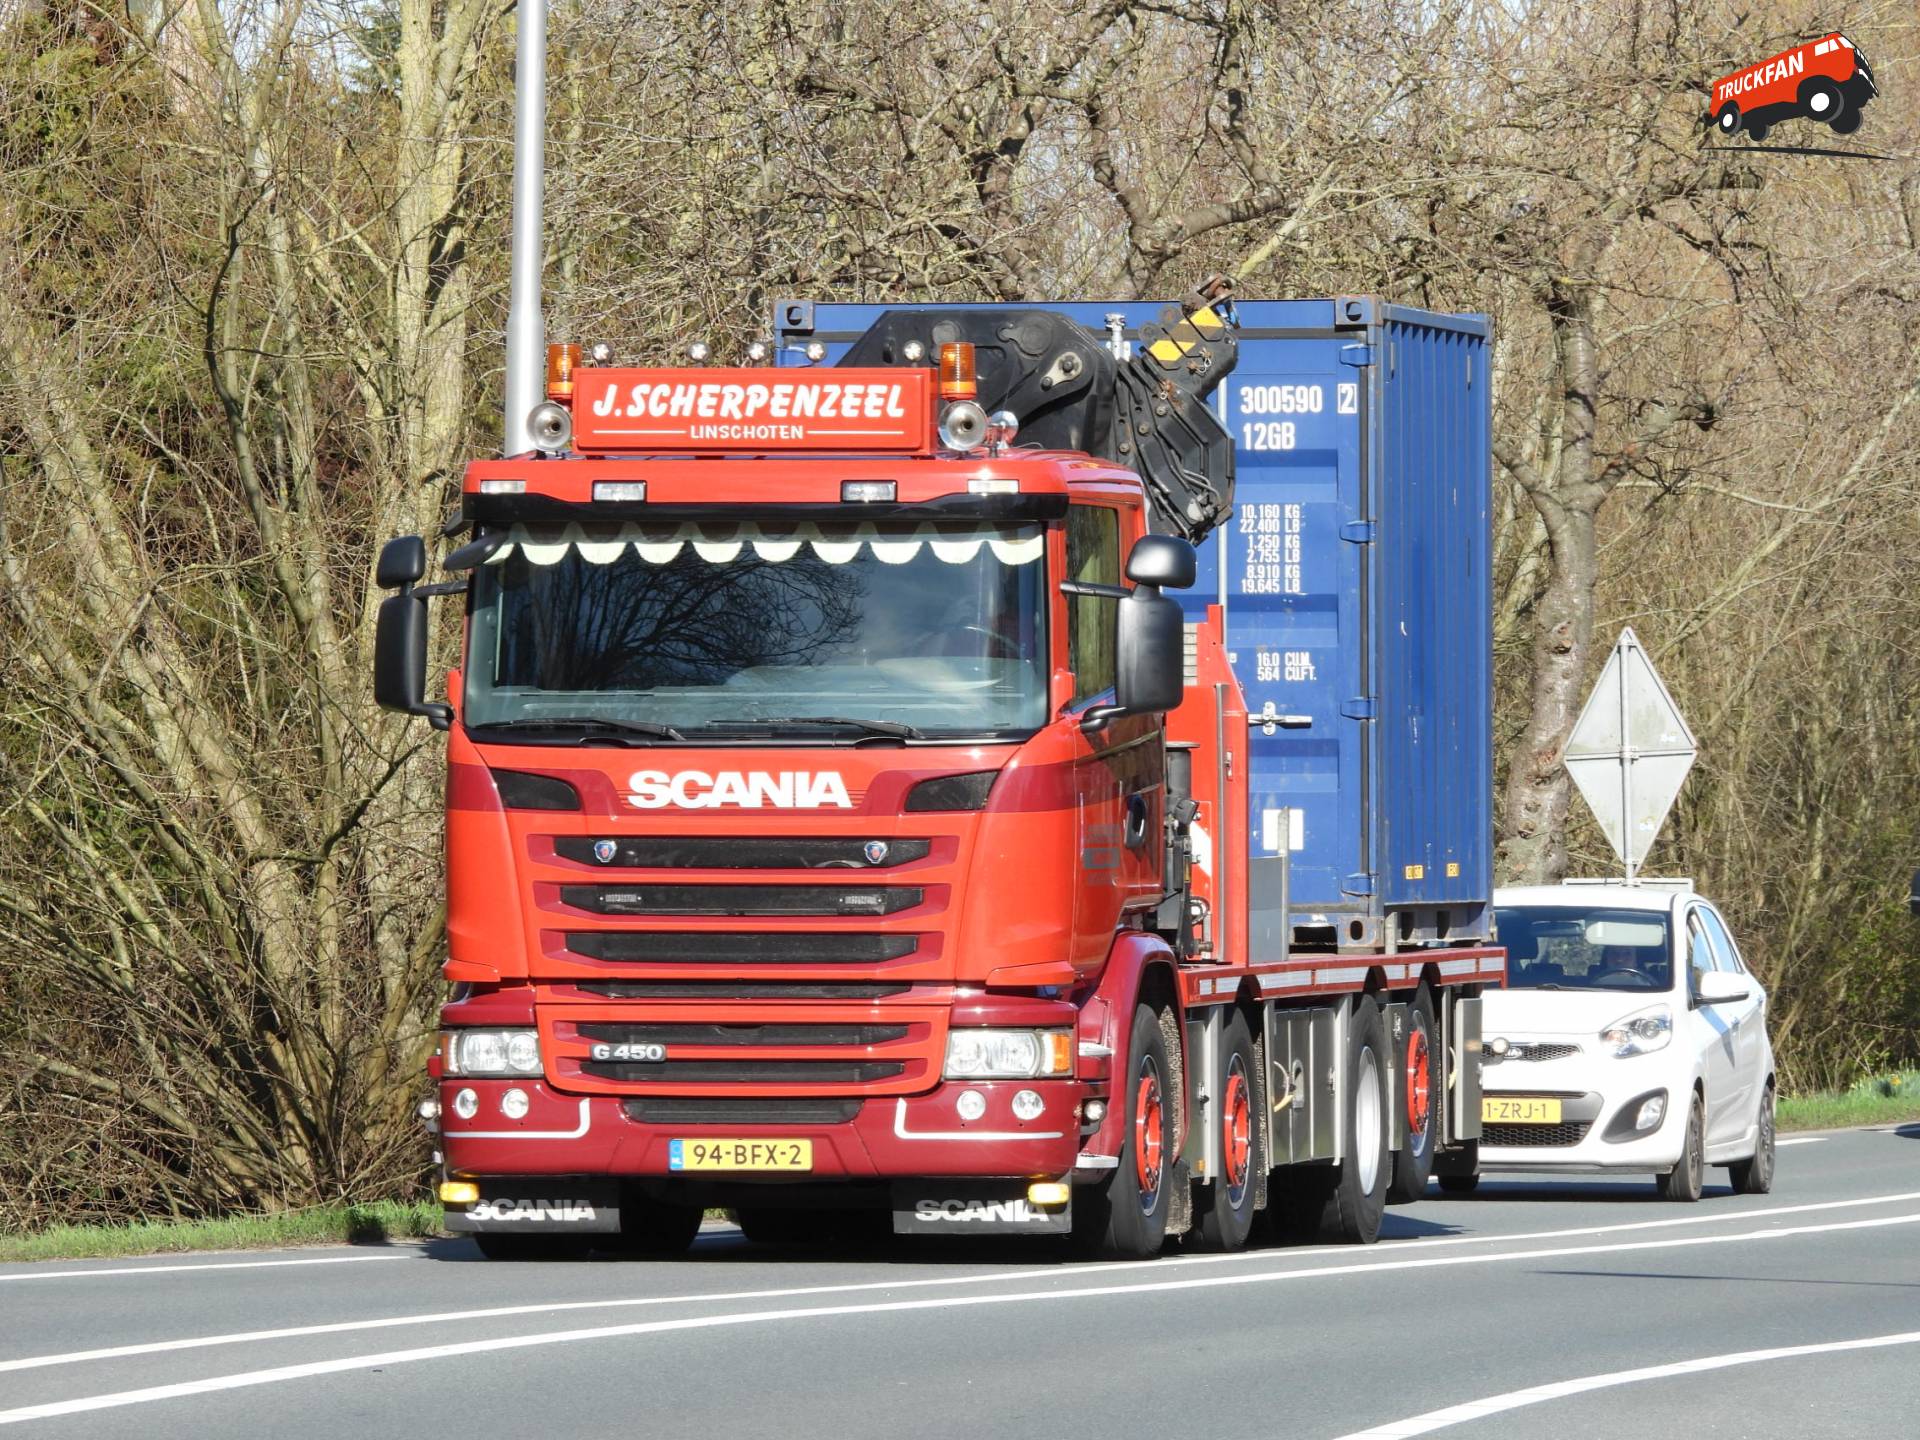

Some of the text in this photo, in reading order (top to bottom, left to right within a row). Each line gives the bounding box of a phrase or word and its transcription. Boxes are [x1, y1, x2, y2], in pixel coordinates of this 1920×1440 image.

[592, 383, 905, 420] J.SCHERPENZEEL
[1240, 384, 1356, 413] 300590 2
[690, 425, 804, 440] LINSCHOTEN
[1243, 422, 1295, 450] 12GB
[1241, 504, 1300, 518] 10.160 KG
[1240, 518, 1300, 533] 22.400 LB
[1248, 534, 1300, 549] 1.250 KG
[1247, 548, 1300, 563] 2.755 LB
[1247, 564, 1300, 579] 8.910 KG
[1241, 578, 1300, 593] 19.645 LB
[1257, 652, 1280, 667] 16.0
[1257, 666, 1280, 681] 564
[627, 770, 853, 809] SCANIA
[593, 1044, 663, 1060] G 450
[1486, 1102, 1547, 1119] 1-ZRJ-1
[693, 1144, 802, 1165] 94-BFX-2
[465, 1198, 597, 1221] SCANIA
[915, 1199, 1050, 1222] SCANIA
